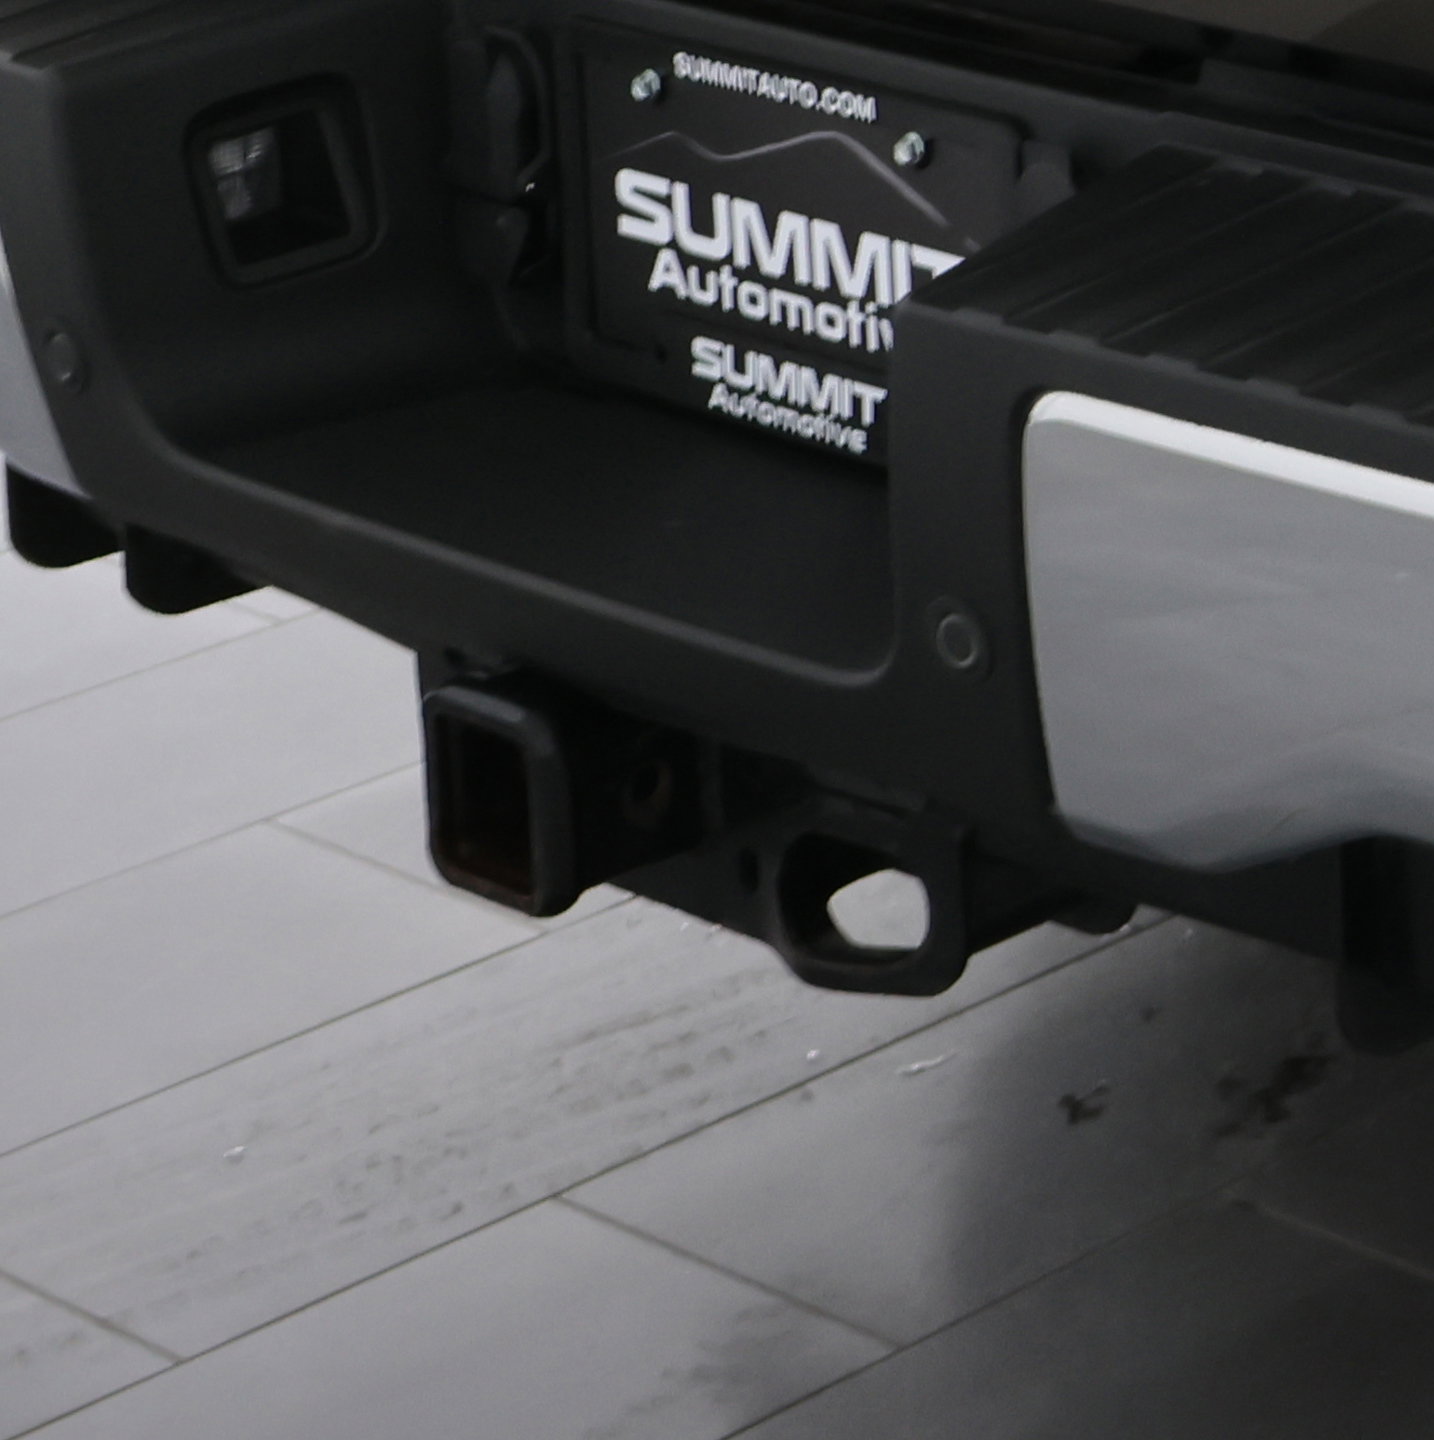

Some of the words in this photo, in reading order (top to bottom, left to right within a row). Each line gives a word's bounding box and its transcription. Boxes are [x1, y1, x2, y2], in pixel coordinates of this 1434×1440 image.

[673, 51, 877, 123] SUMMITAUTO.COM
[691, 336, 888, 426] SUMMIT
[708, 382, 868, 454] Automotive
